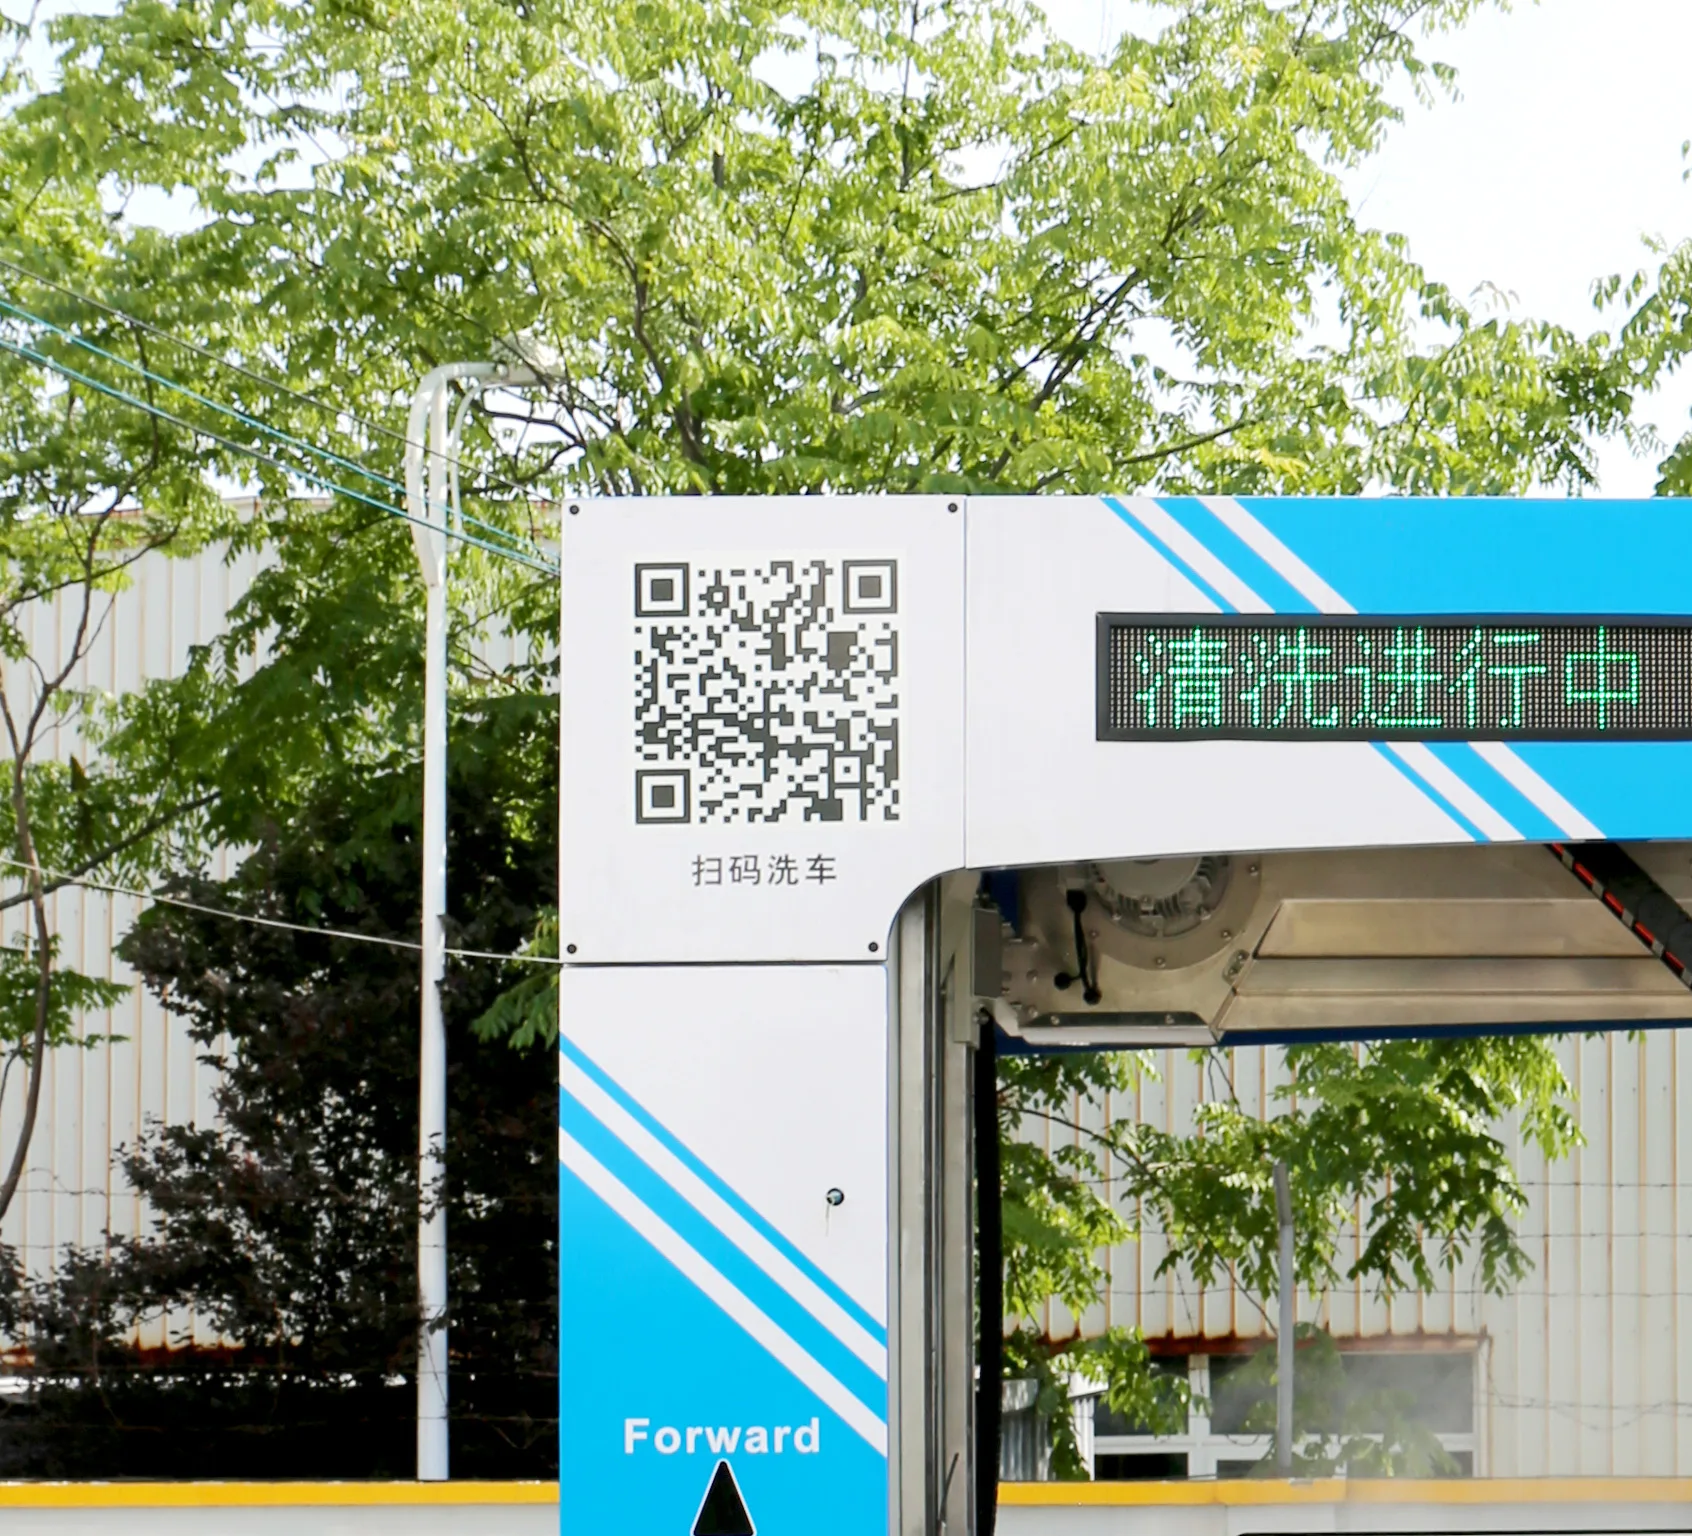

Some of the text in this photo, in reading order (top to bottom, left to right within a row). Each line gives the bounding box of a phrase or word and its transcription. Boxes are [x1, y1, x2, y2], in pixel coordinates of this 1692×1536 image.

[1135, 625, 1641, 731] 清洗进行中
[692, 853, 837, 887] 扫码洗车
[624, 1416, 821, 1454] Forward
